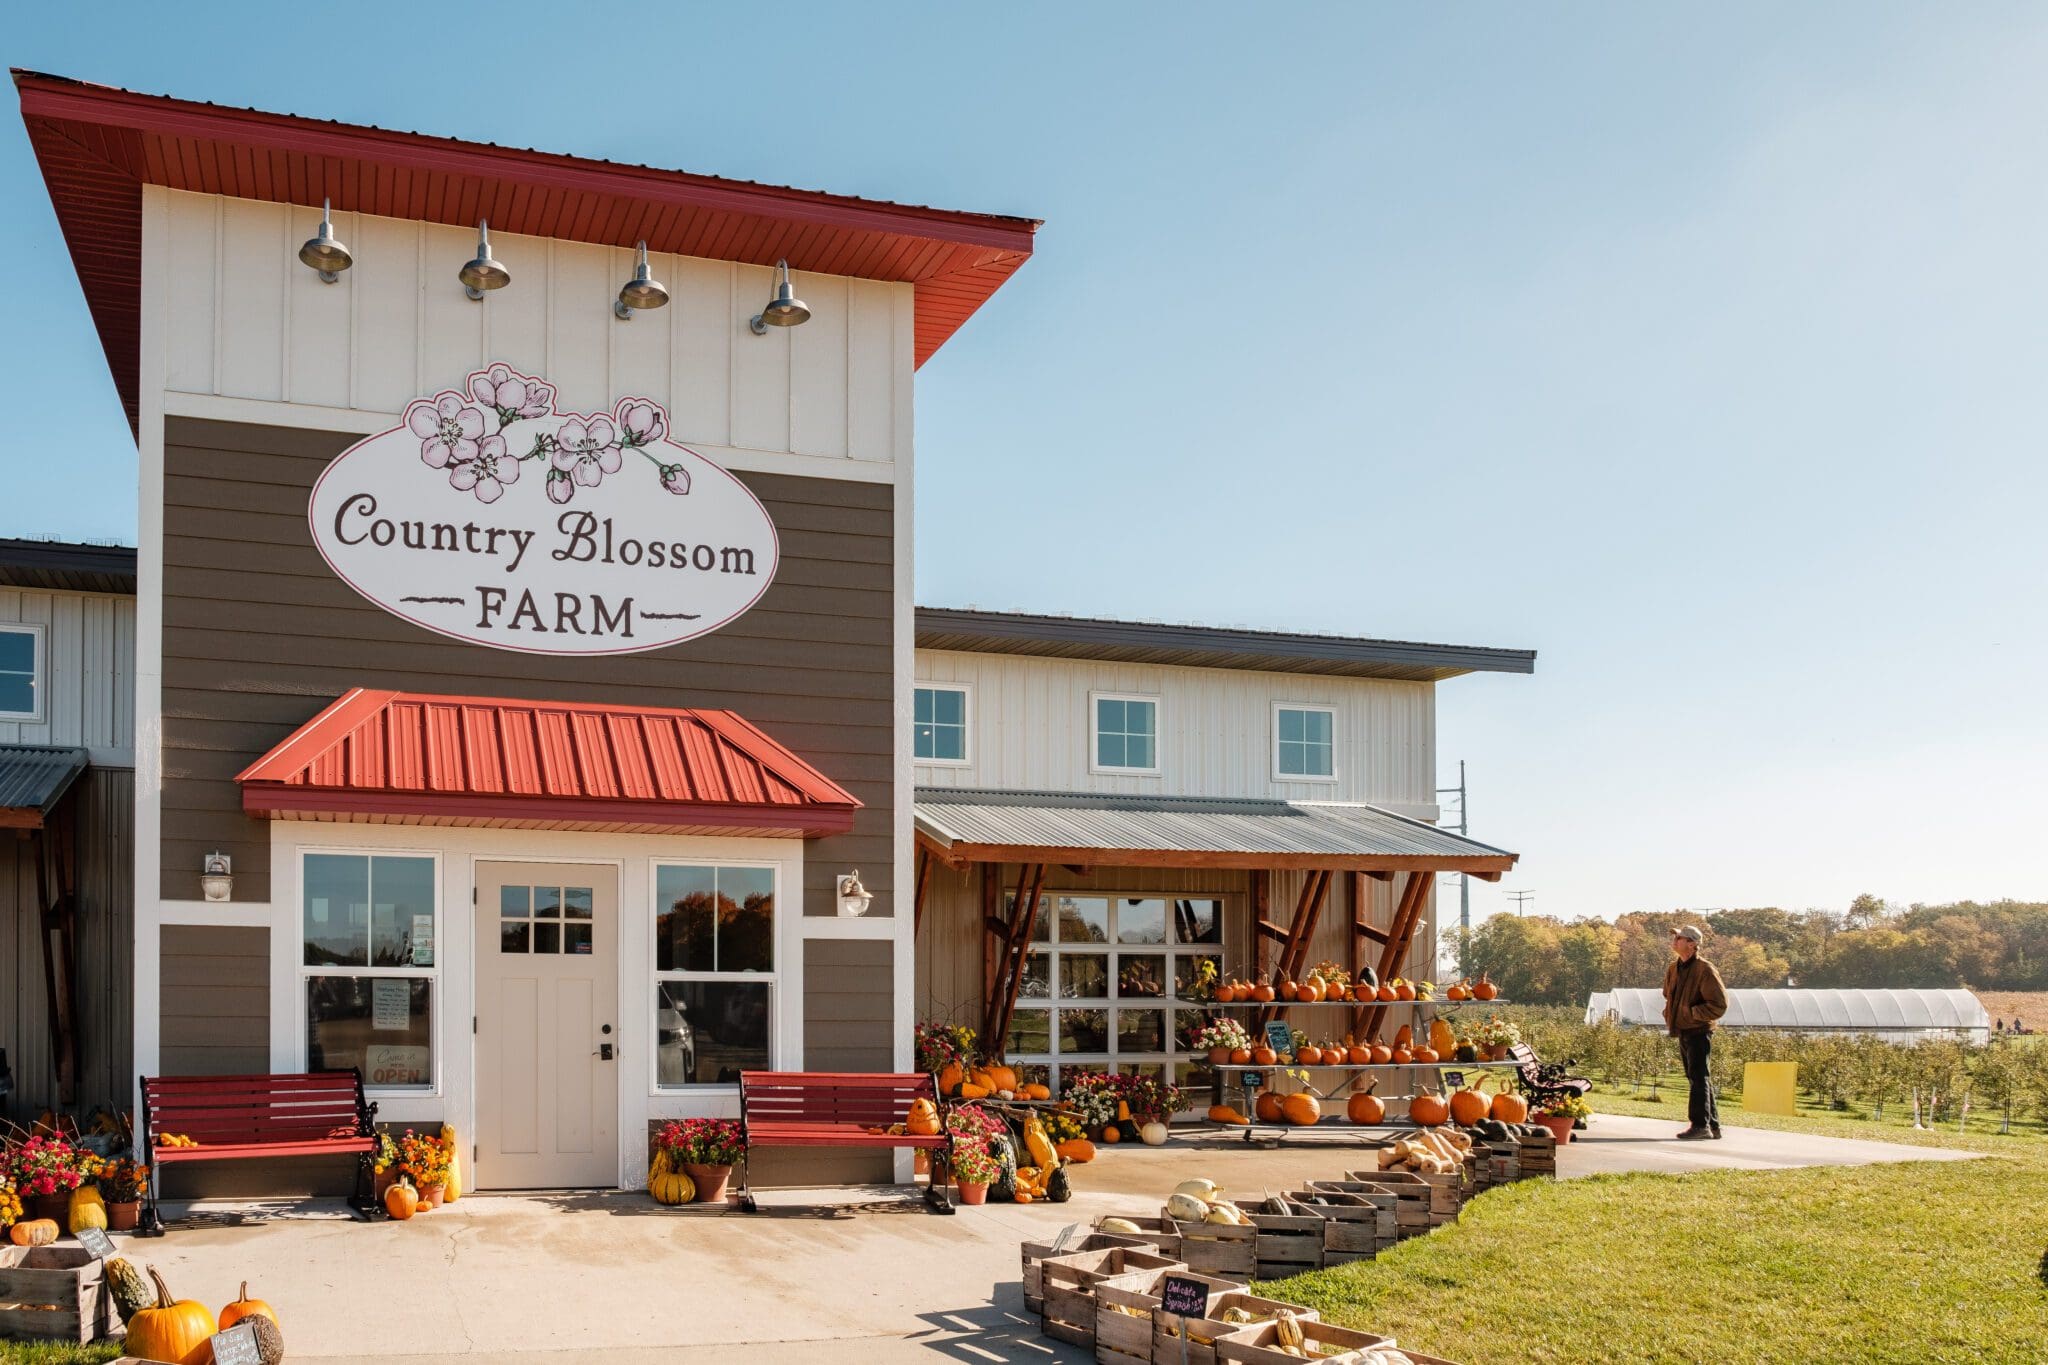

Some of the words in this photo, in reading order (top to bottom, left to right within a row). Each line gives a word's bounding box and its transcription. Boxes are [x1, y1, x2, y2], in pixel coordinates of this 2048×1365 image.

[334, 493, 535, 573] Country
[552, 510, 756, 575] Blossom
[475, 585, 634, 638] FARM
[373, 1068, 420, 1083] OPEN
